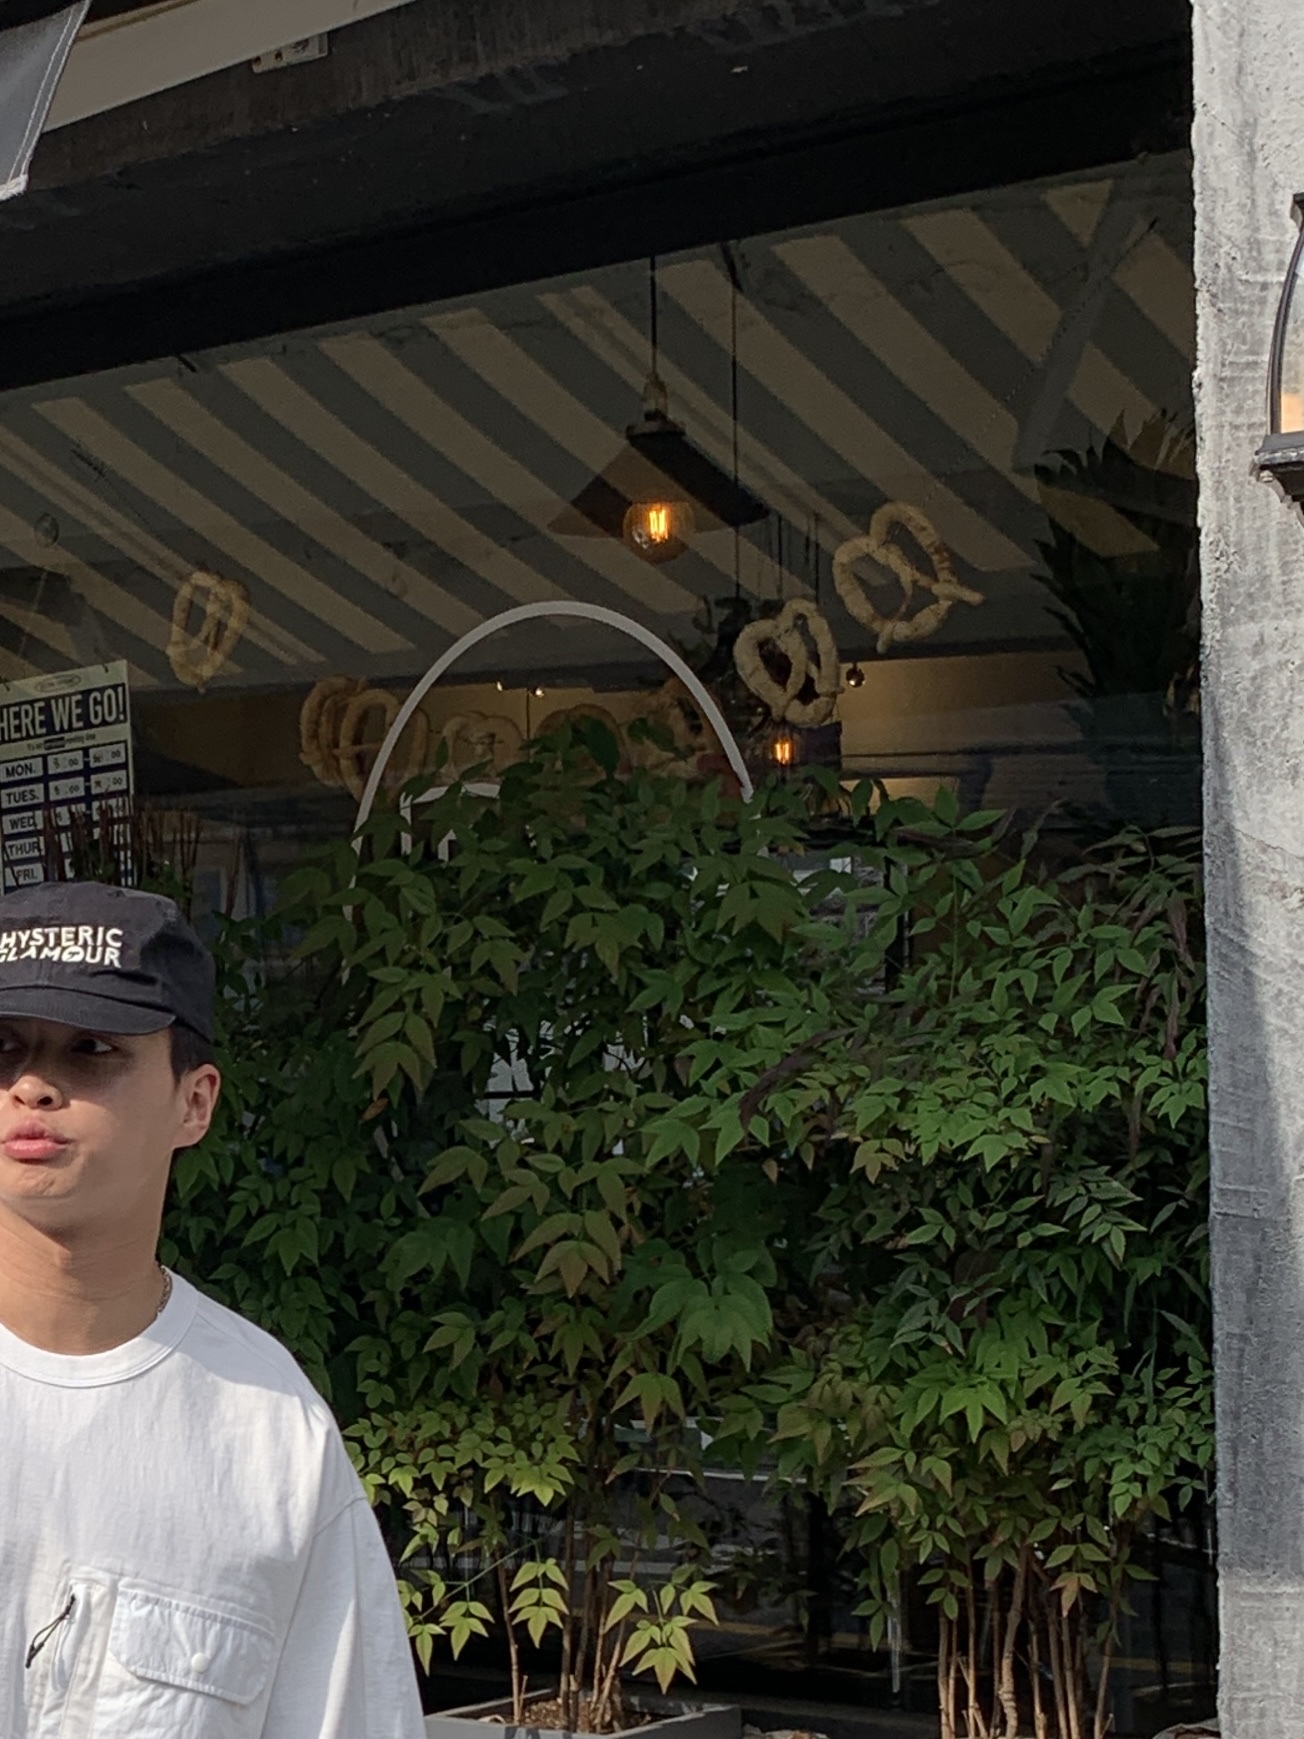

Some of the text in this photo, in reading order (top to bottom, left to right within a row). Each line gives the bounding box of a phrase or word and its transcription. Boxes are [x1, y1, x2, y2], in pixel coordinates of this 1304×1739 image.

[51, 693, 84, 732] WE
[89, 685, 125, 726] GO!
[5, 763, 36, 778] MON.
[5, 789, 40, 804] TUES.
